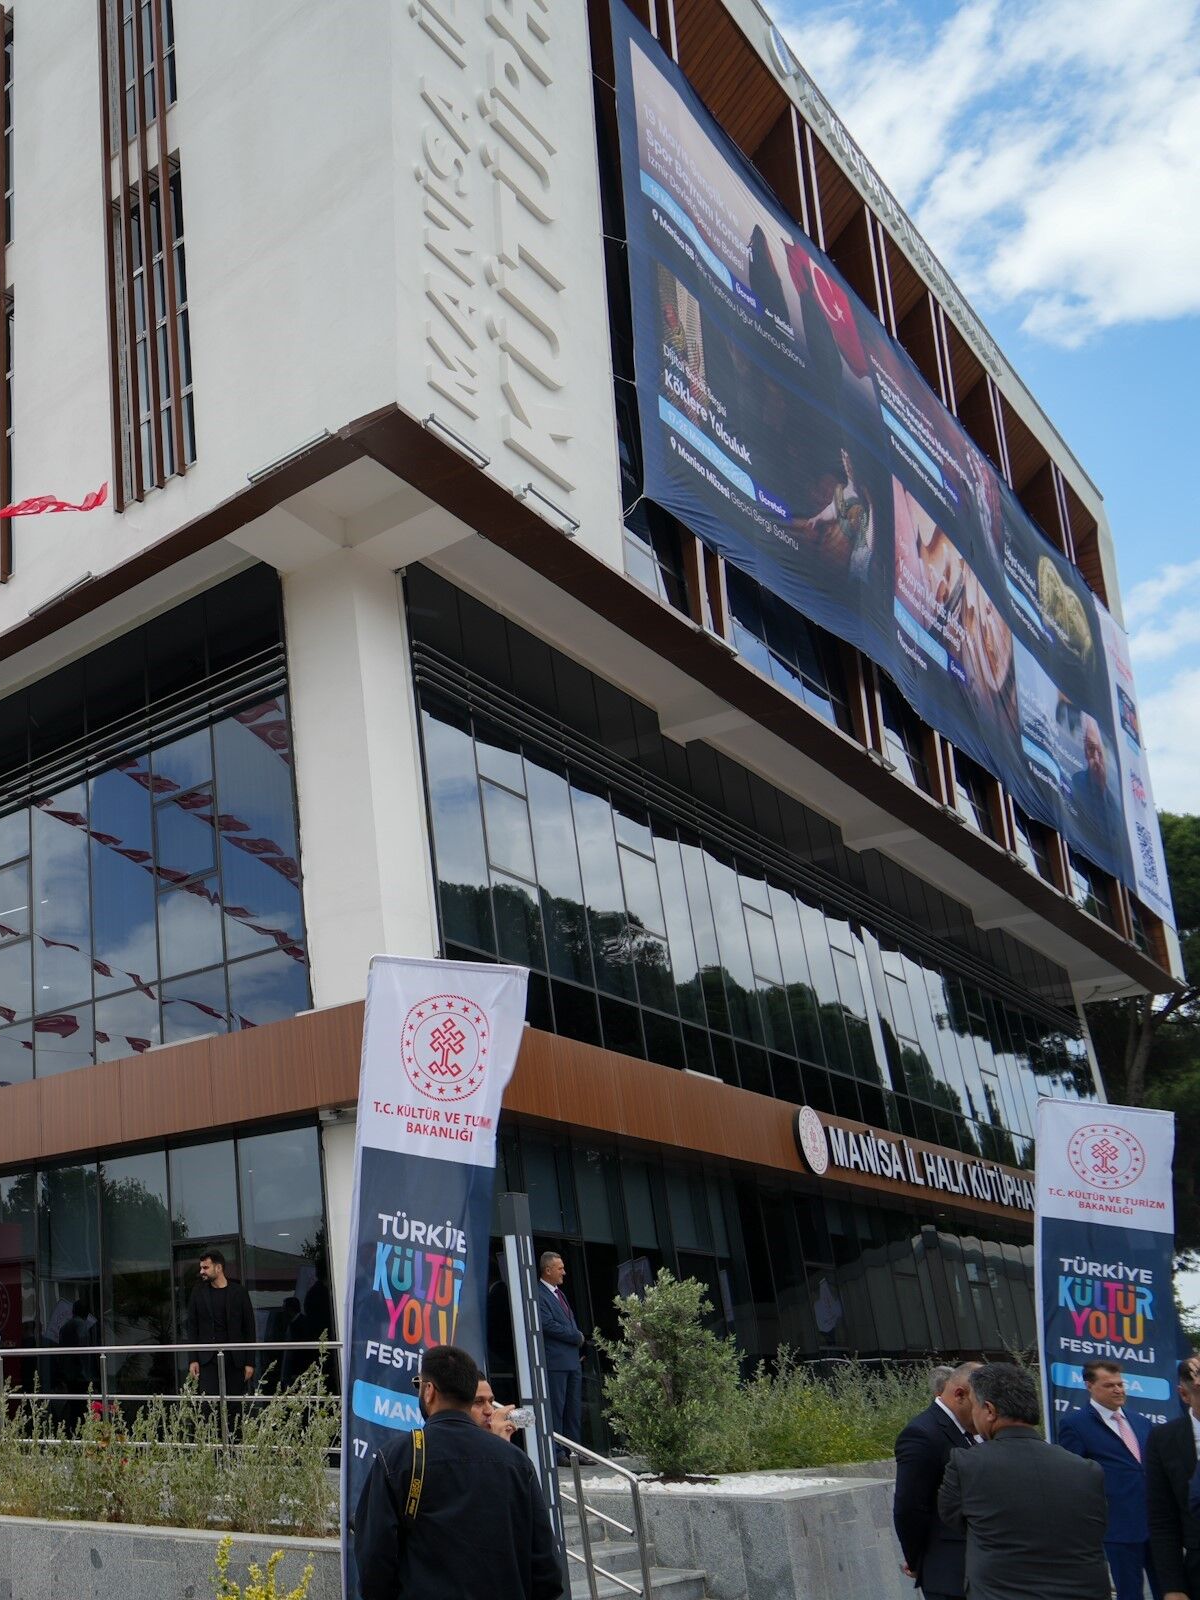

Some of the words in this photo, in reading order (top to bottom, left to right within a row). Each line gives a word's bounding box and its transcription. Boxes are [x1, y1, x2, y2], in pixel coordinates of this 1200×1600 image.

[646, 128, 674, 167] Spor
[414, 74, 480, 421] MANİSA
[477, 0, 577, 493] KÜTÜPH
[659, 215, 685, 249] Manisa
[664, 368, 708, 422] Köklere
[709, 410, 752, 466] Yolculuk
[678, 443, 706, 477] Manisa
[706, 467, 730, 499] Müzesi
[773, 523, 799, 550] Salonu
[373, 1101, 394, 1115] T.C.
[397, 1104, 440, 1122] KÜLTÜR
[445, 1112, 460, 1125] VE
[406, 1122, 474, 1142] BAKANLIĞI
[828, 1125, 907, 1182] MANİSA
[903, 1139, 925, 1186] İL
[921, 1151, 971, 1196] HALK
[1048, 1187, 1066, 1198] T.C.
[1068, 1189, 1105, 1202] KÜLTÜR
[1109, 1196, 1121, 1204] VE
[1124, 1197, 1166, 1209] TURİZM
[1078, 1201, 1134, 1215] BAKANLIĞI
[373, 1241, 466, 1308] KÜLTÜR
[1059, 1256, 1153, 1285] TÜRKİYE
[1058, 1275, 1154, 1321] KÜLTÜR
[1070, 1307, 1144, 1345] YOLU
[366, 1340, 424, 1374] FESTİ
[1059, 1336, 1156, 1364] FESTİVALİ
[374, 1396, 425, 1428] MAN
[1054, 1399, 1070, 1412] 17
[353, 1438, 368, 1459] 17
